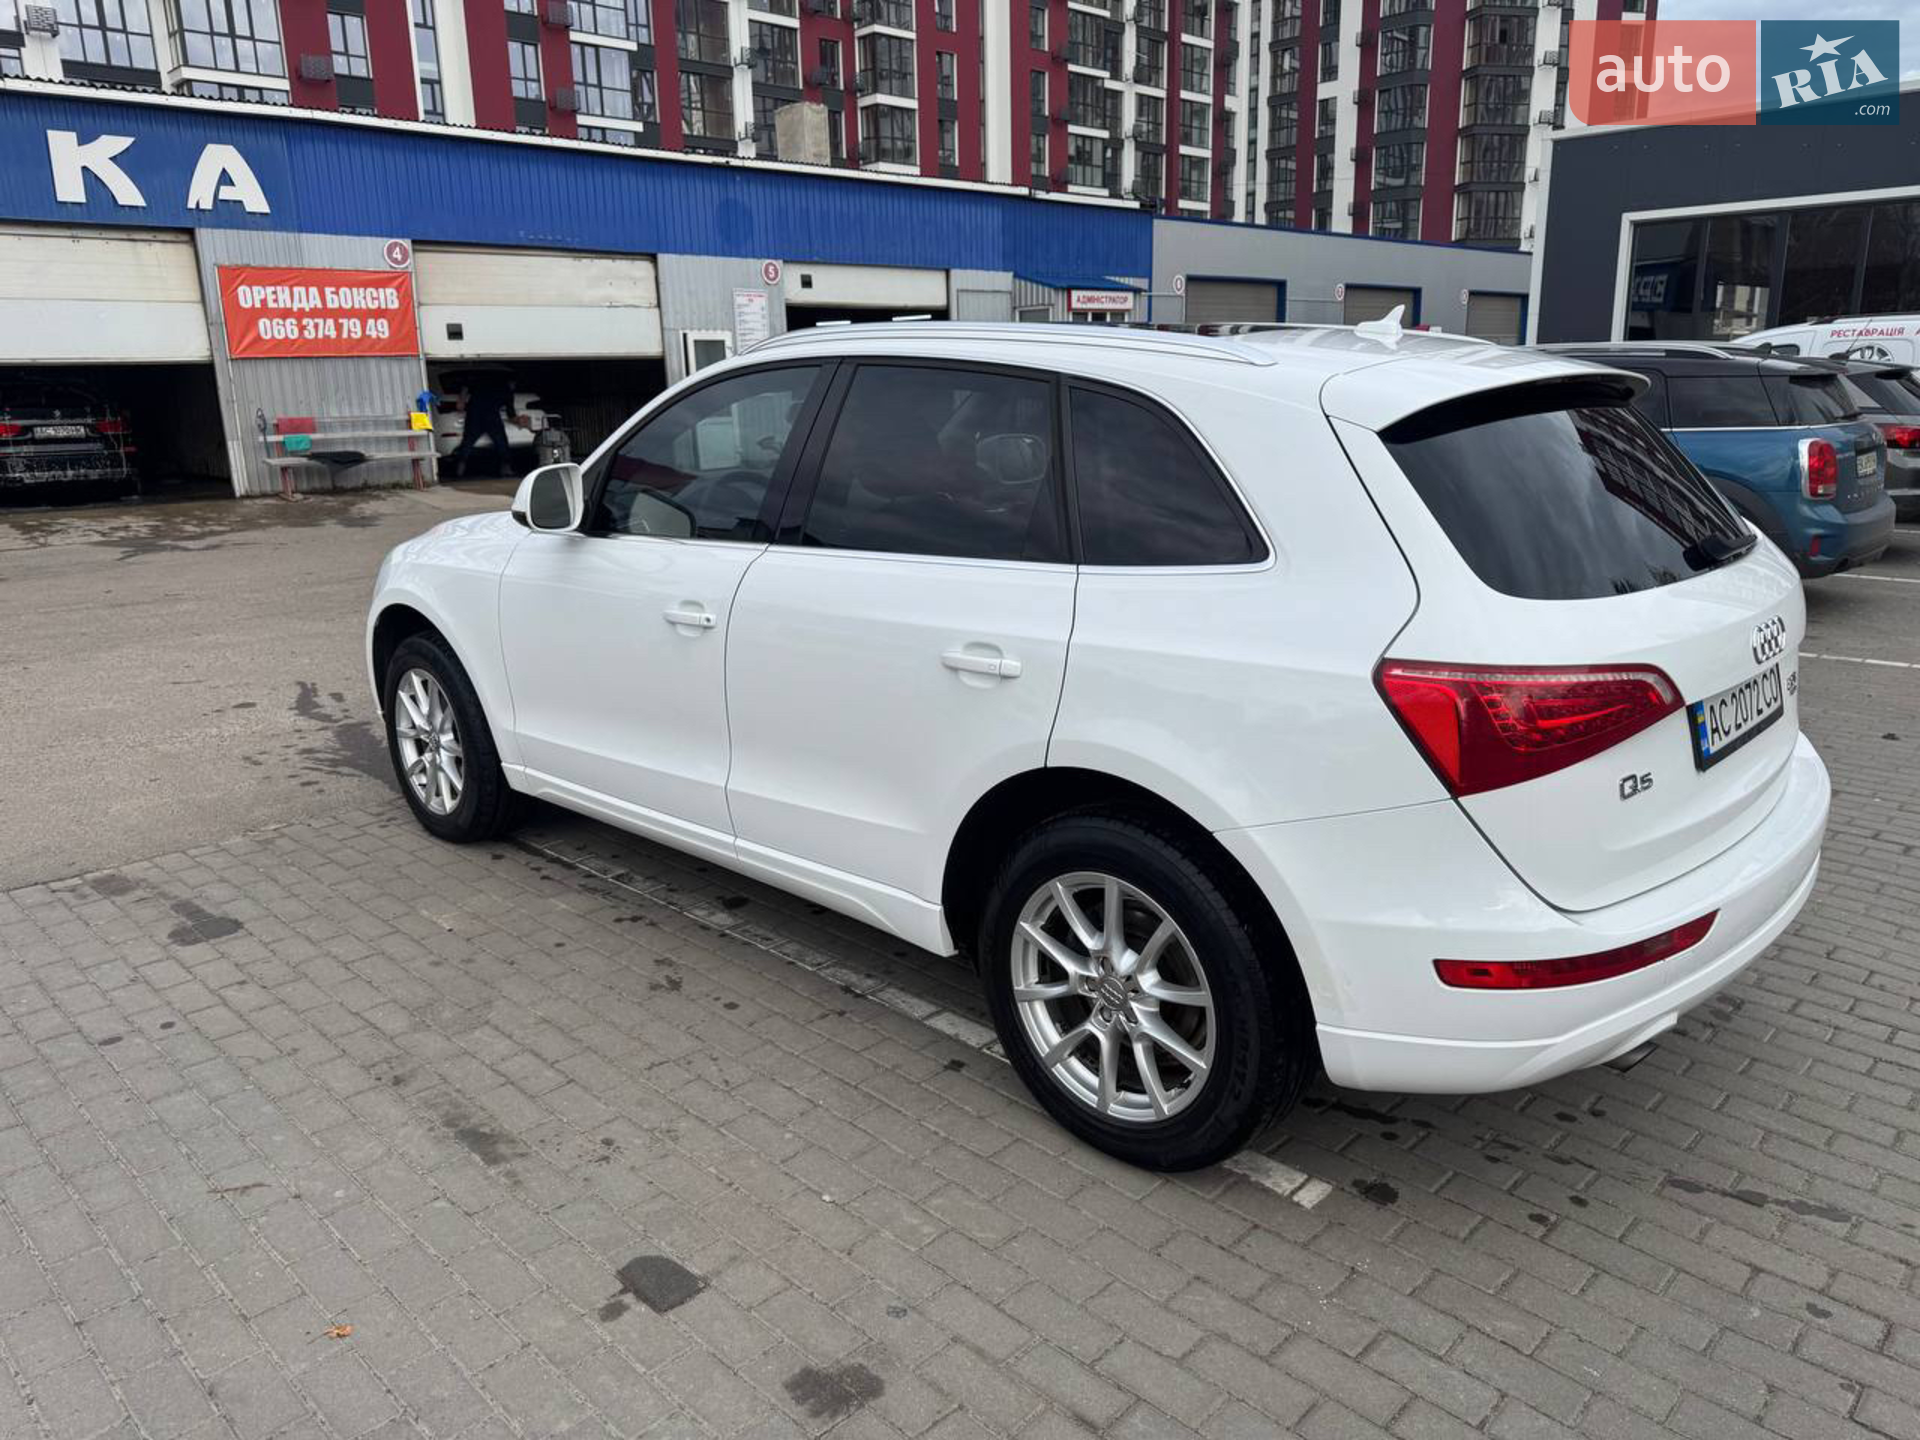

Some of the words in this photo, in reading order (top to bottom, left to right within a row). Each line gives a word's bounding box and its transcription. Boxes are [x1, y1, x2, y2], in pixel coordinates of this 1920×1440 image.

[236, 285, 323, 312] ОРЕНДА
[324, 286, 400, 310] БОКСІВ
[257, 317, 299, 340] 066
[302, 317, 337, 340] 374
[338, 317, 362, 340] 79
[365, 317, 390, 340] 49
[1829, 326, 1906, 338] РЕСТАВРАЦІЯ
[1709, 698, 1732, 747] AC
[1730, 678, 1764, 732] 2072
[1619, 772, 1654, 801] Q5
